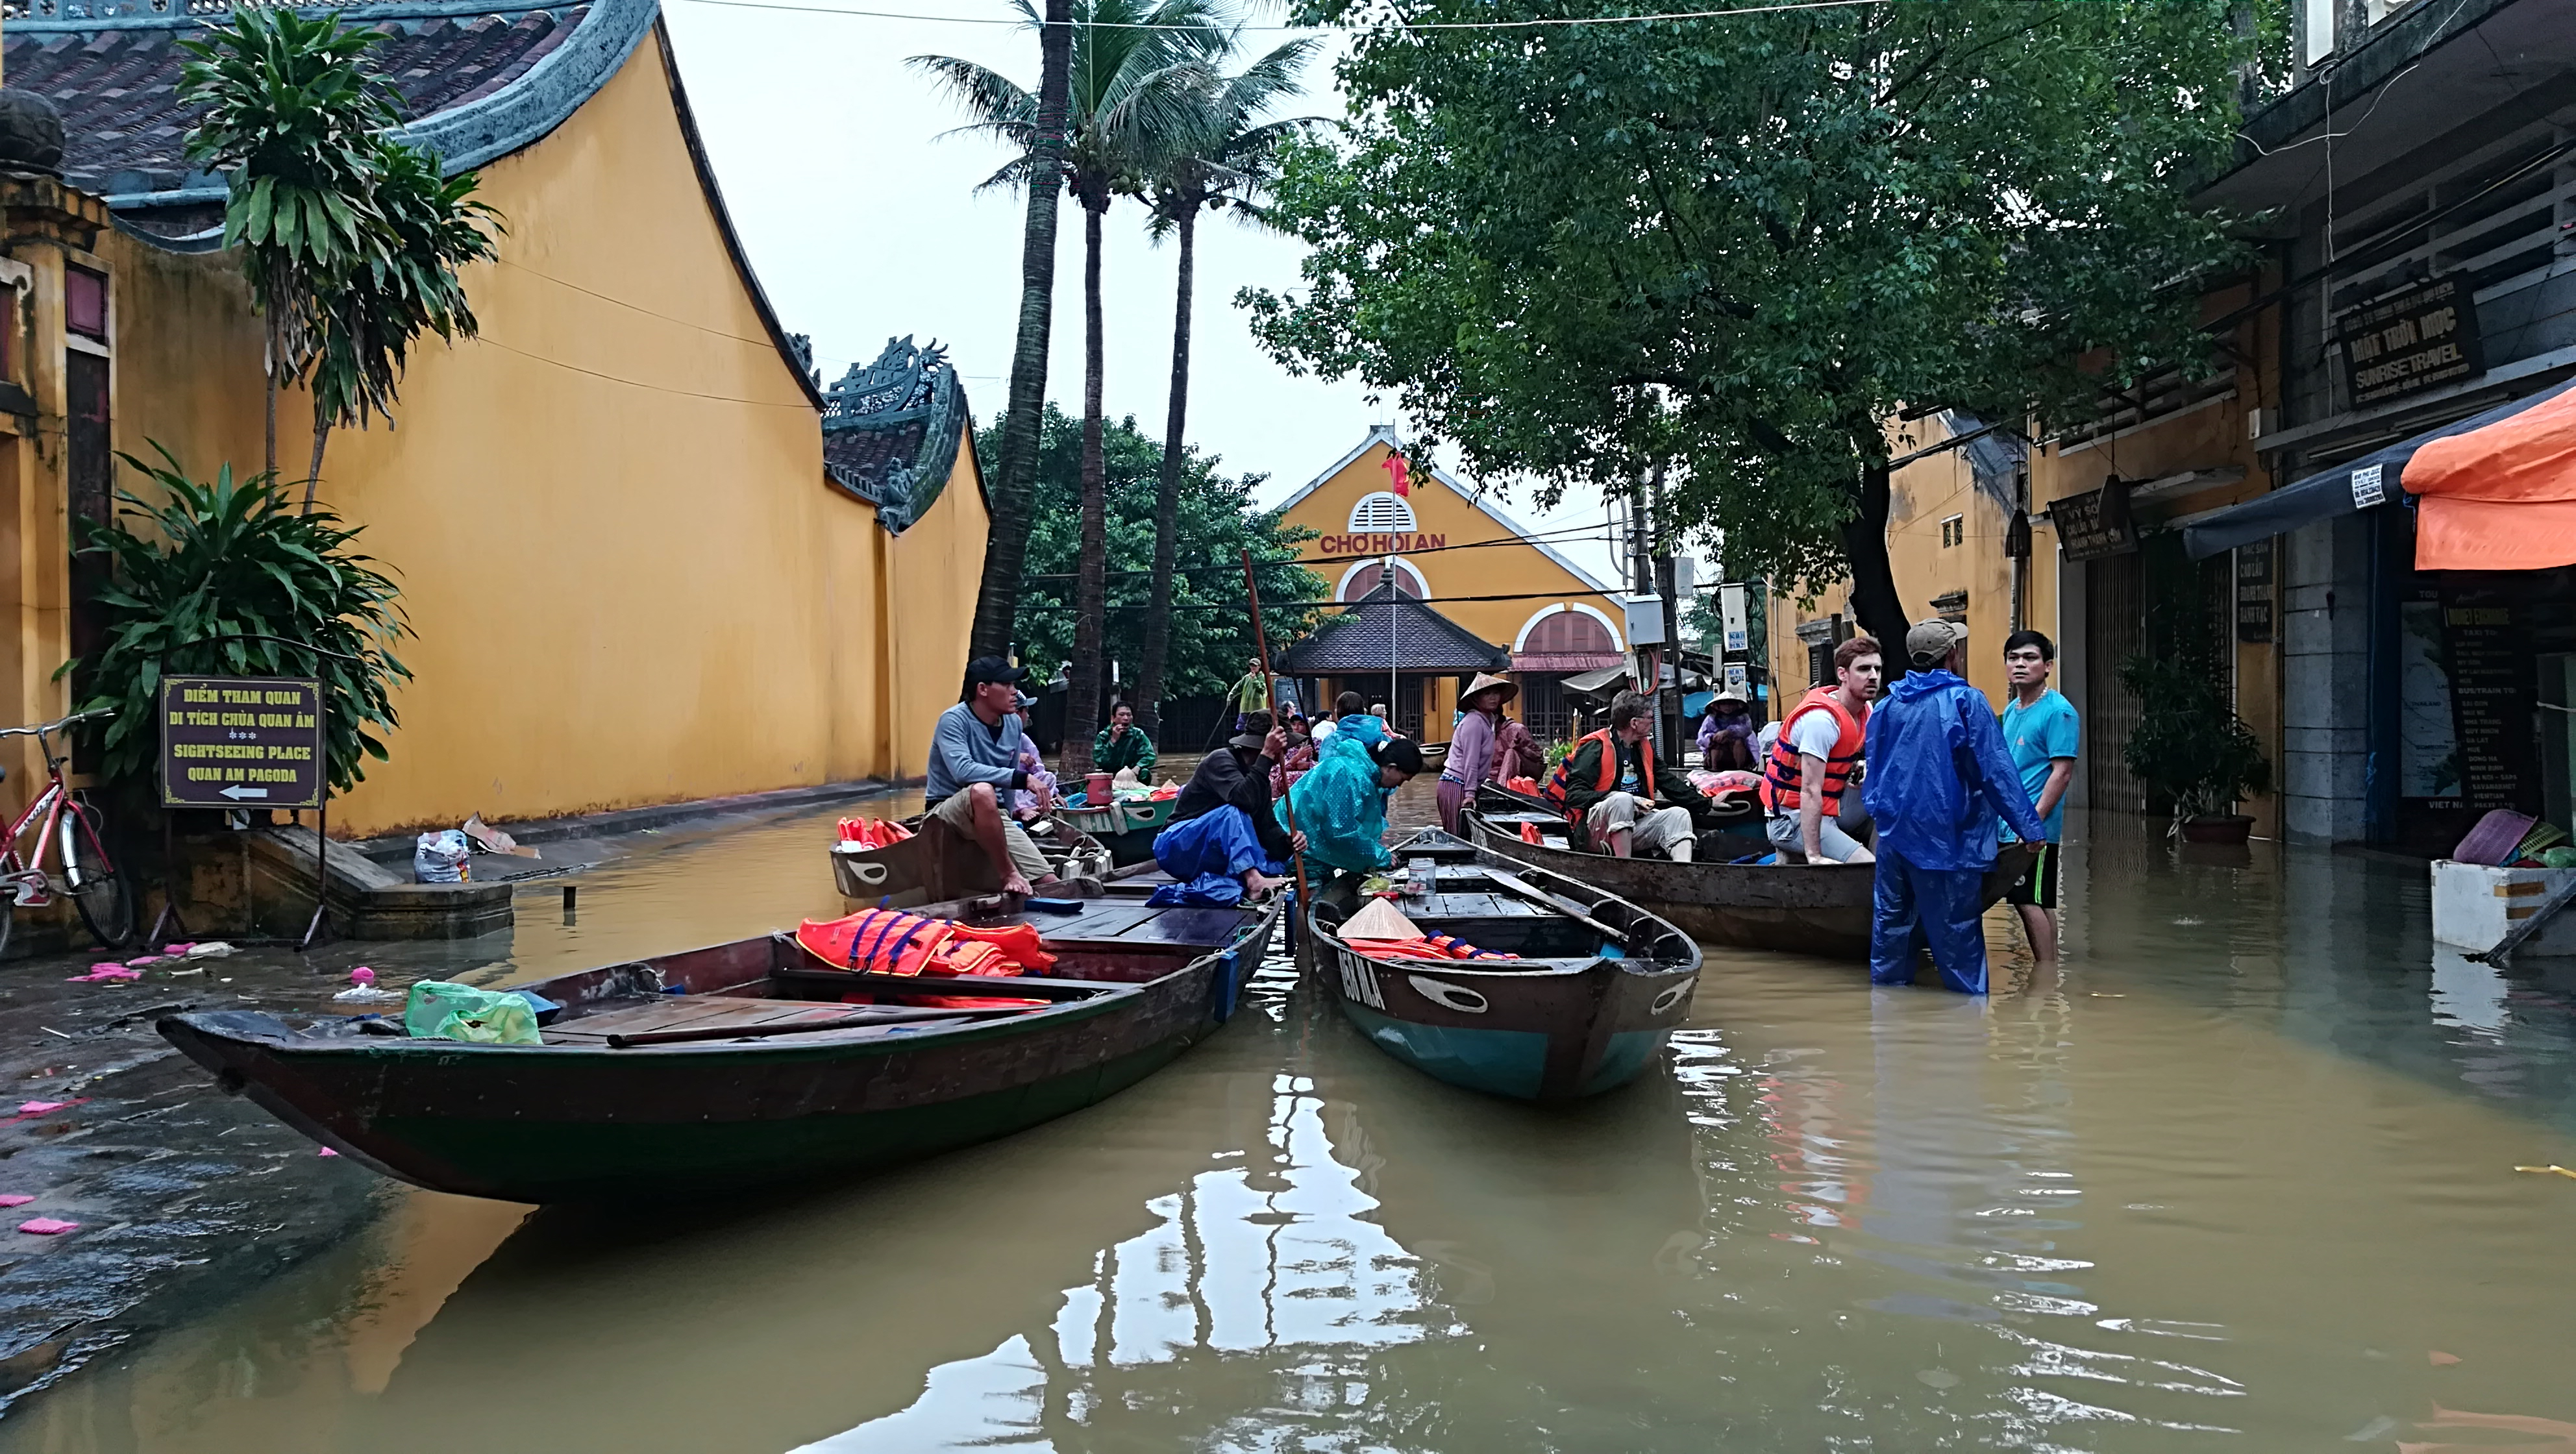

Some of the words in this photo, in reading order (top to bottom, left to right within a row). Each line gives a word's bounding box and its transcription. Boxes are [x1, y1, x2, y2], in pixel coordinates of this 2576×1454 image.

[2420, 306, 2457, 340] MỌC
[2355, 358, 2410, 389] SUNRISE
[2408, 342, 2463, 373] TRAVEL
[1320, 533, 1368, 556] CHỢ
[1373, 532, 1409, 556] HỘI
[1415, 534, 1445, 550] AN
[222, 690, 261, 704] THAM
[266, 691, 301, 705] QUAN
[186, 709, 218, 726] TÍCH
[221, 709, 255, 726] CHÙA
[259, 713, 291, 728] QUAN
[295, 711, 315, 728] ÂM
[174, 745, 264, 759] SIGHTSEEING
[268, 746, 311, 760] PLACE
[188, 767, 221, 782] QUAN
[225, 768, 245, 781] AM
[248, 769, 297, 782] PAGODA
[2428, 801, 2450, 809] VIET
